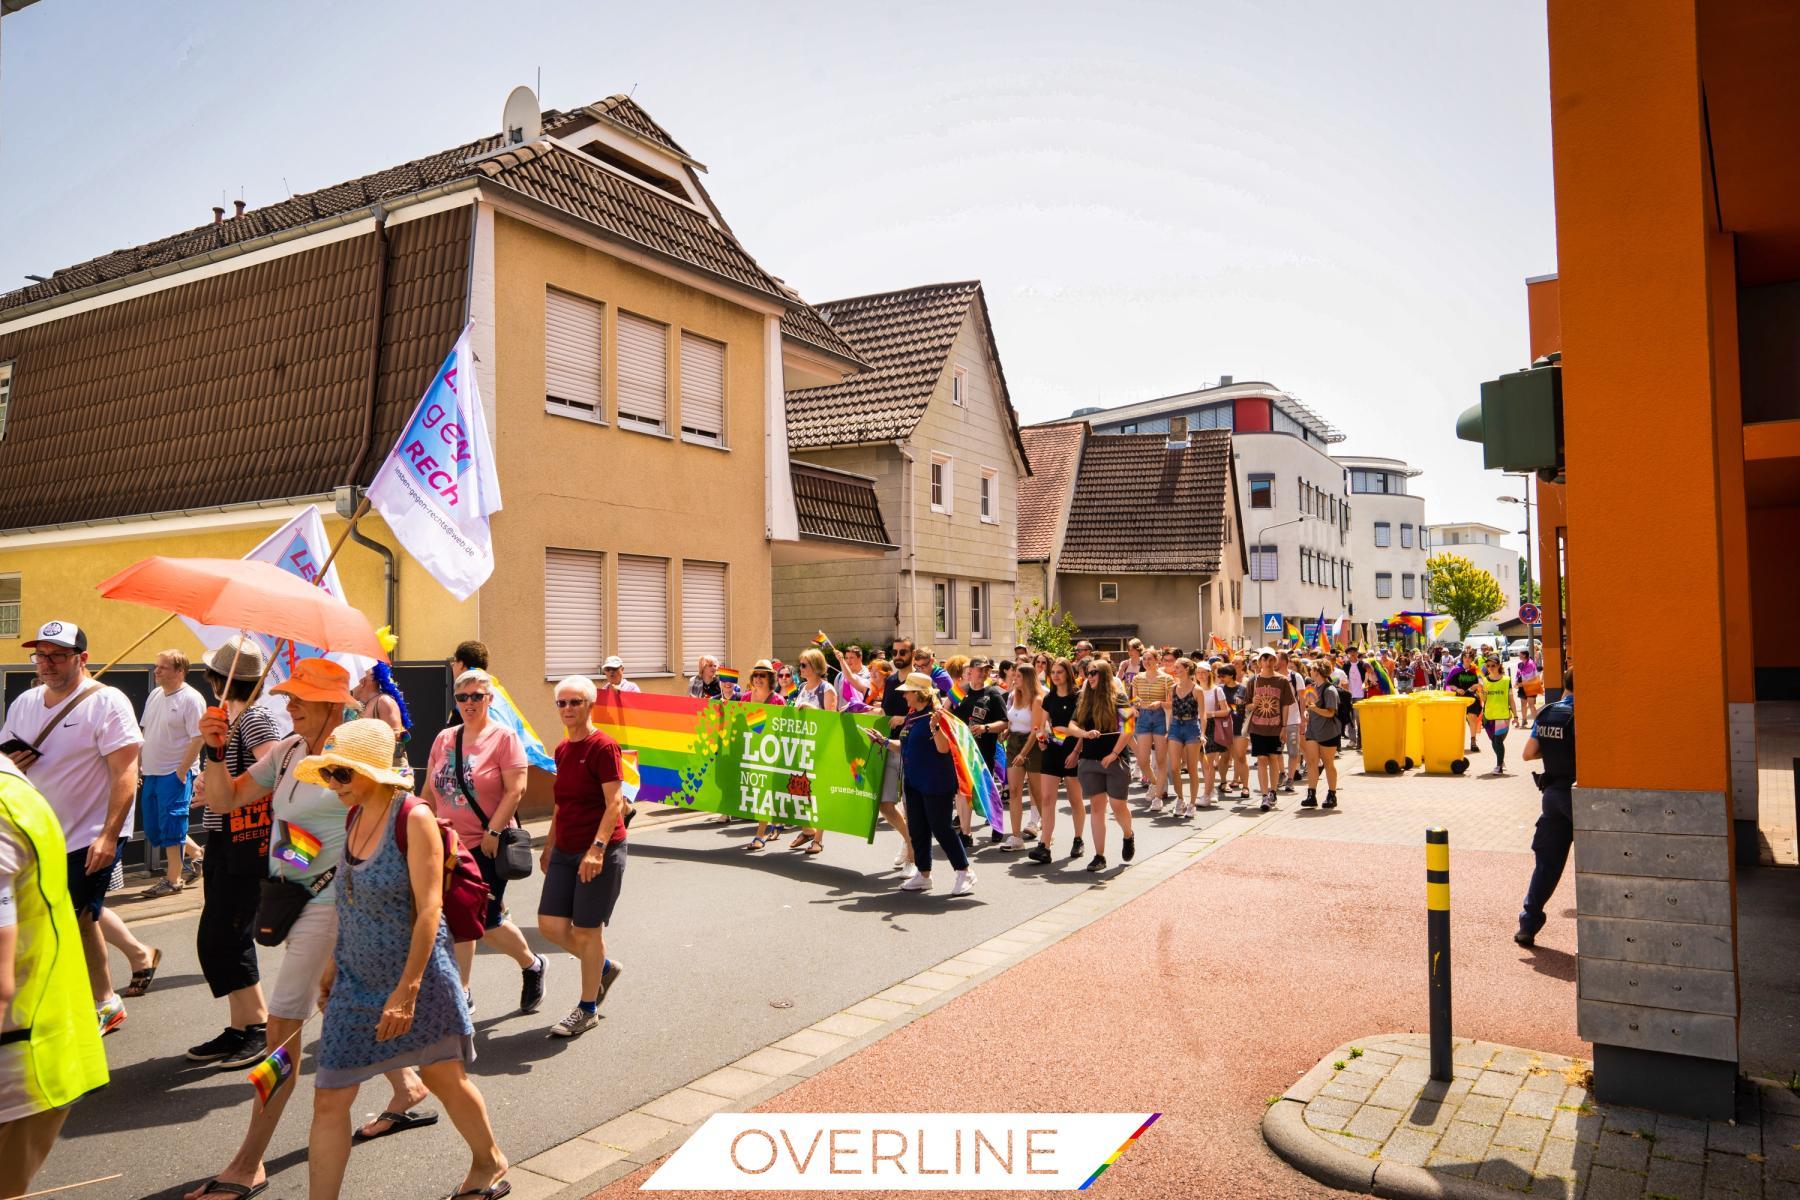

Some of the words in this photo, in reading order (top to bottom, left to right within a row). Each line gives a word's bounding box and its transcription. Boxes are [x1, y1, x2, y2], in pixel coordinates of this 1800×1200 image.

[771, 717, 818, 736] SPREAD
[1536, 725, 1563, 740] POLIZEI
[742, 732, 816, 770] LOVE
[740, 771, 767, 787] NOT
[739, 785, 819, 822] HATE!
